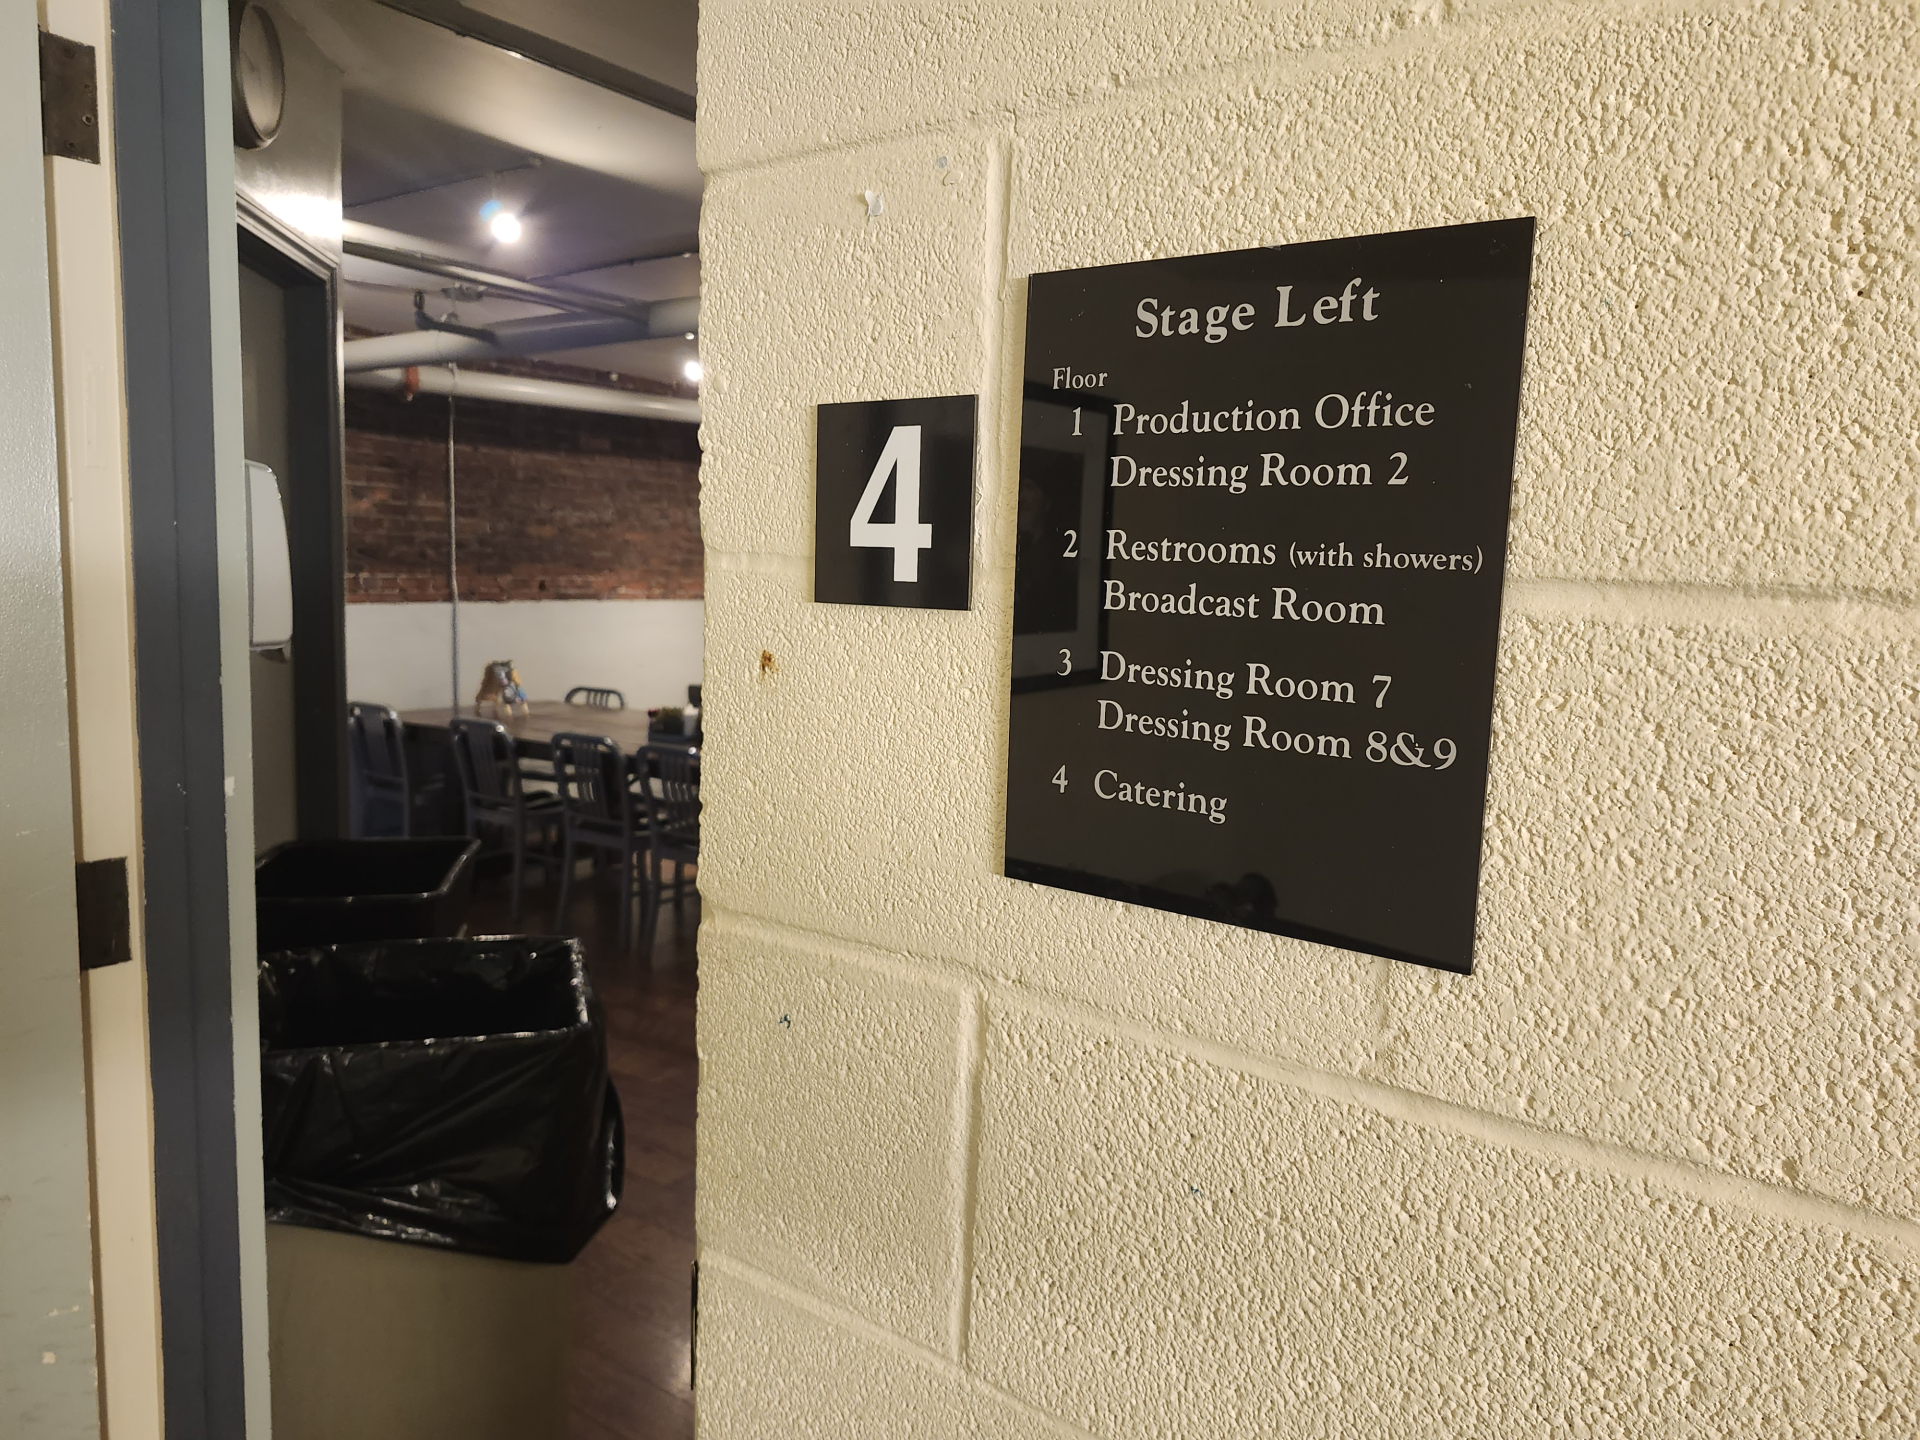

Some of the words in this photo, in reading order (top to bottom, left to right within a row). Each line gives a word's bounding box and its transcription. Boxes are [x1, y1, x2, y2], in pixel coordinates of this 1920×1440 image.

[1135, 297, 1256, 344] Stage
[1274, 277, 1381, 328] Left
[1052, 366, 1108, 390] Floor
[1071, 406, 1083, 436] 1
[1112, 399, 1302, 436] Production
[1314, 390, 1435, 429] Office
[1110, 455, 1249, 495] Dressing
[1259, 452, 1373, 487] Room
[1387, 451, 1409, 485] 2
[849, 424, 933, 583] 4
[1062, 529, 1079, 558] 2
[1106, 529, 1276, 565] Restrooms
[1289, 541, 1355, 569] (with
[1362, 542, 1483, 575] showers)
[1103, 579, 1260, 619] Broadcast
[1271, 587, 1386, 626] Room
[1056, 648, 1072, 676] 3
[1099, 650, 1235, 700] Dressing
[1245, 662, 1357, 704] Room
[1372, 674, 1392, 709] 7
[1097, 699, 1232, 752] Dressing
[1242, 715, 1353, 759] Room
[1365, 730, 1457, 770] 8&9
[1051, 764, 1069, 794] 4
[1094, 769, 1228, 825] Catering
